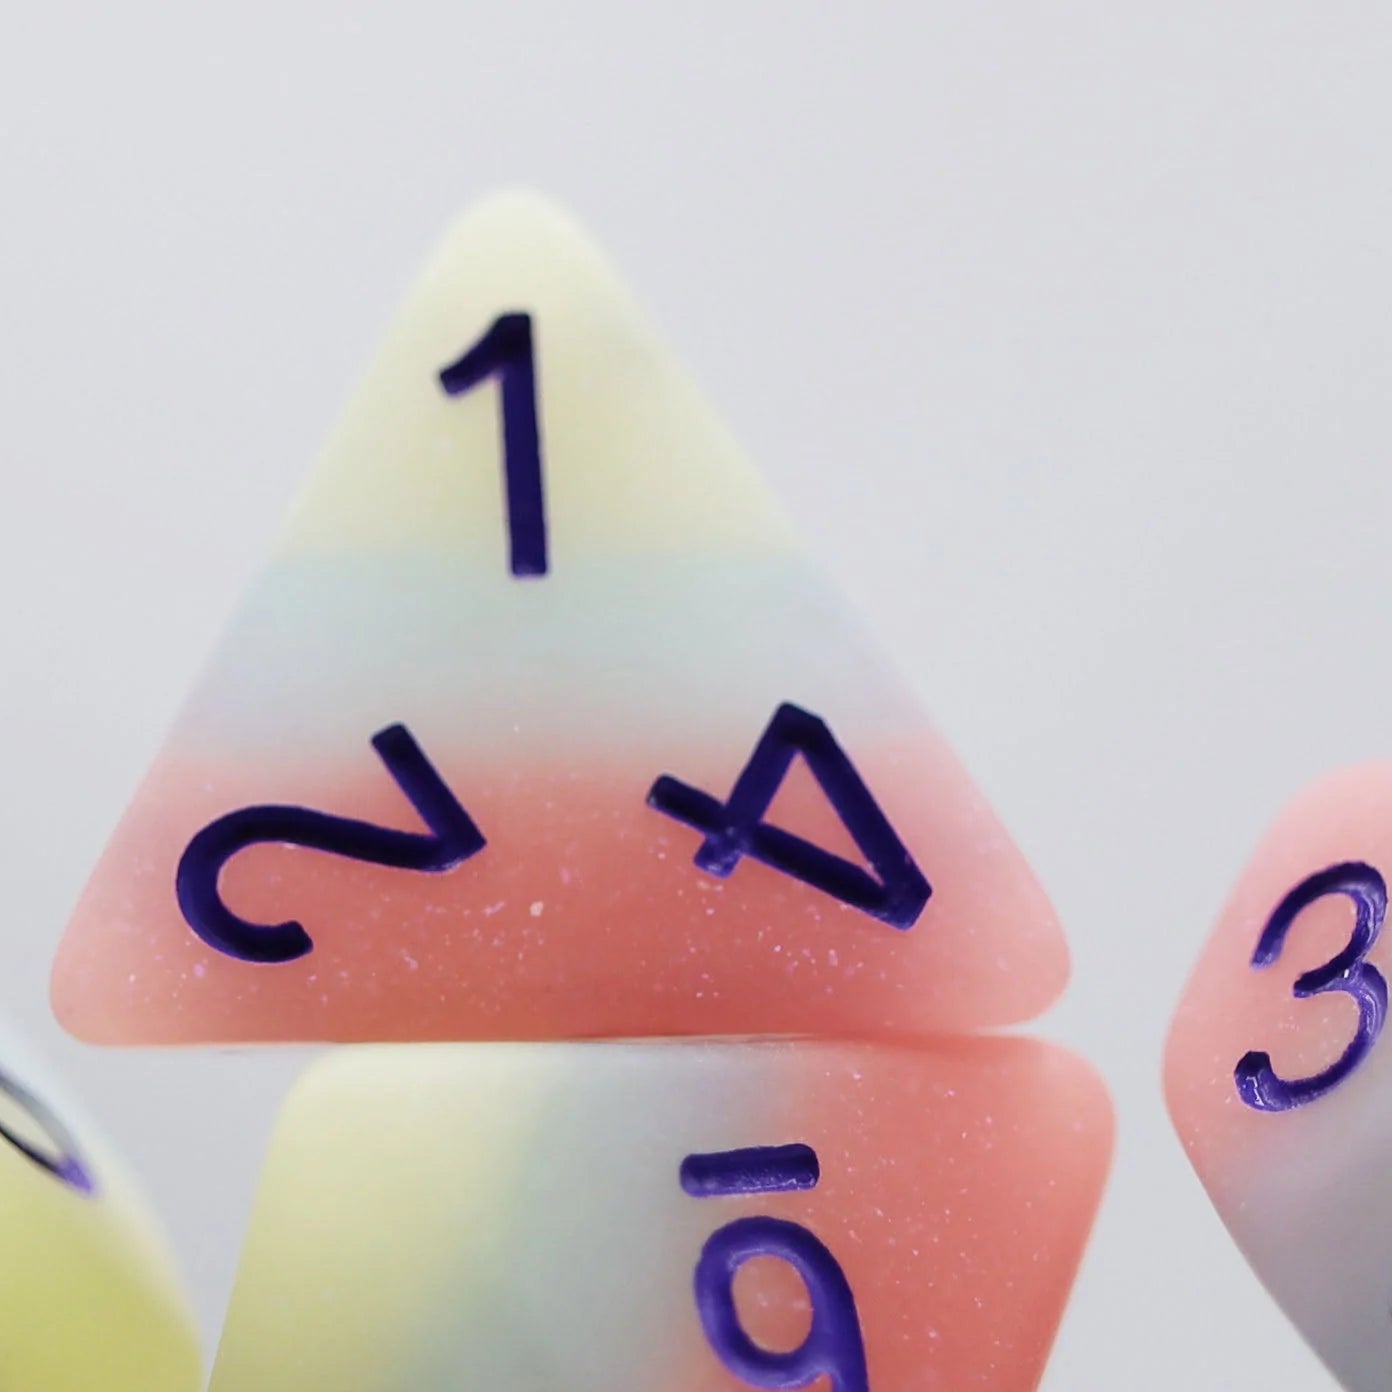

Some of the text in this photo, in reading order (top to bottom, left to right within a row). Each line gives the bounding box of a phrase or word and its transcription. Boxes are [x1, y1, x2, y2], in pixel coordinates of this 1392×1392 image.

[439, 309, 552, 579] 1
[175, 720, 487, 965] 2
[645, 701, 934, 932] 4
